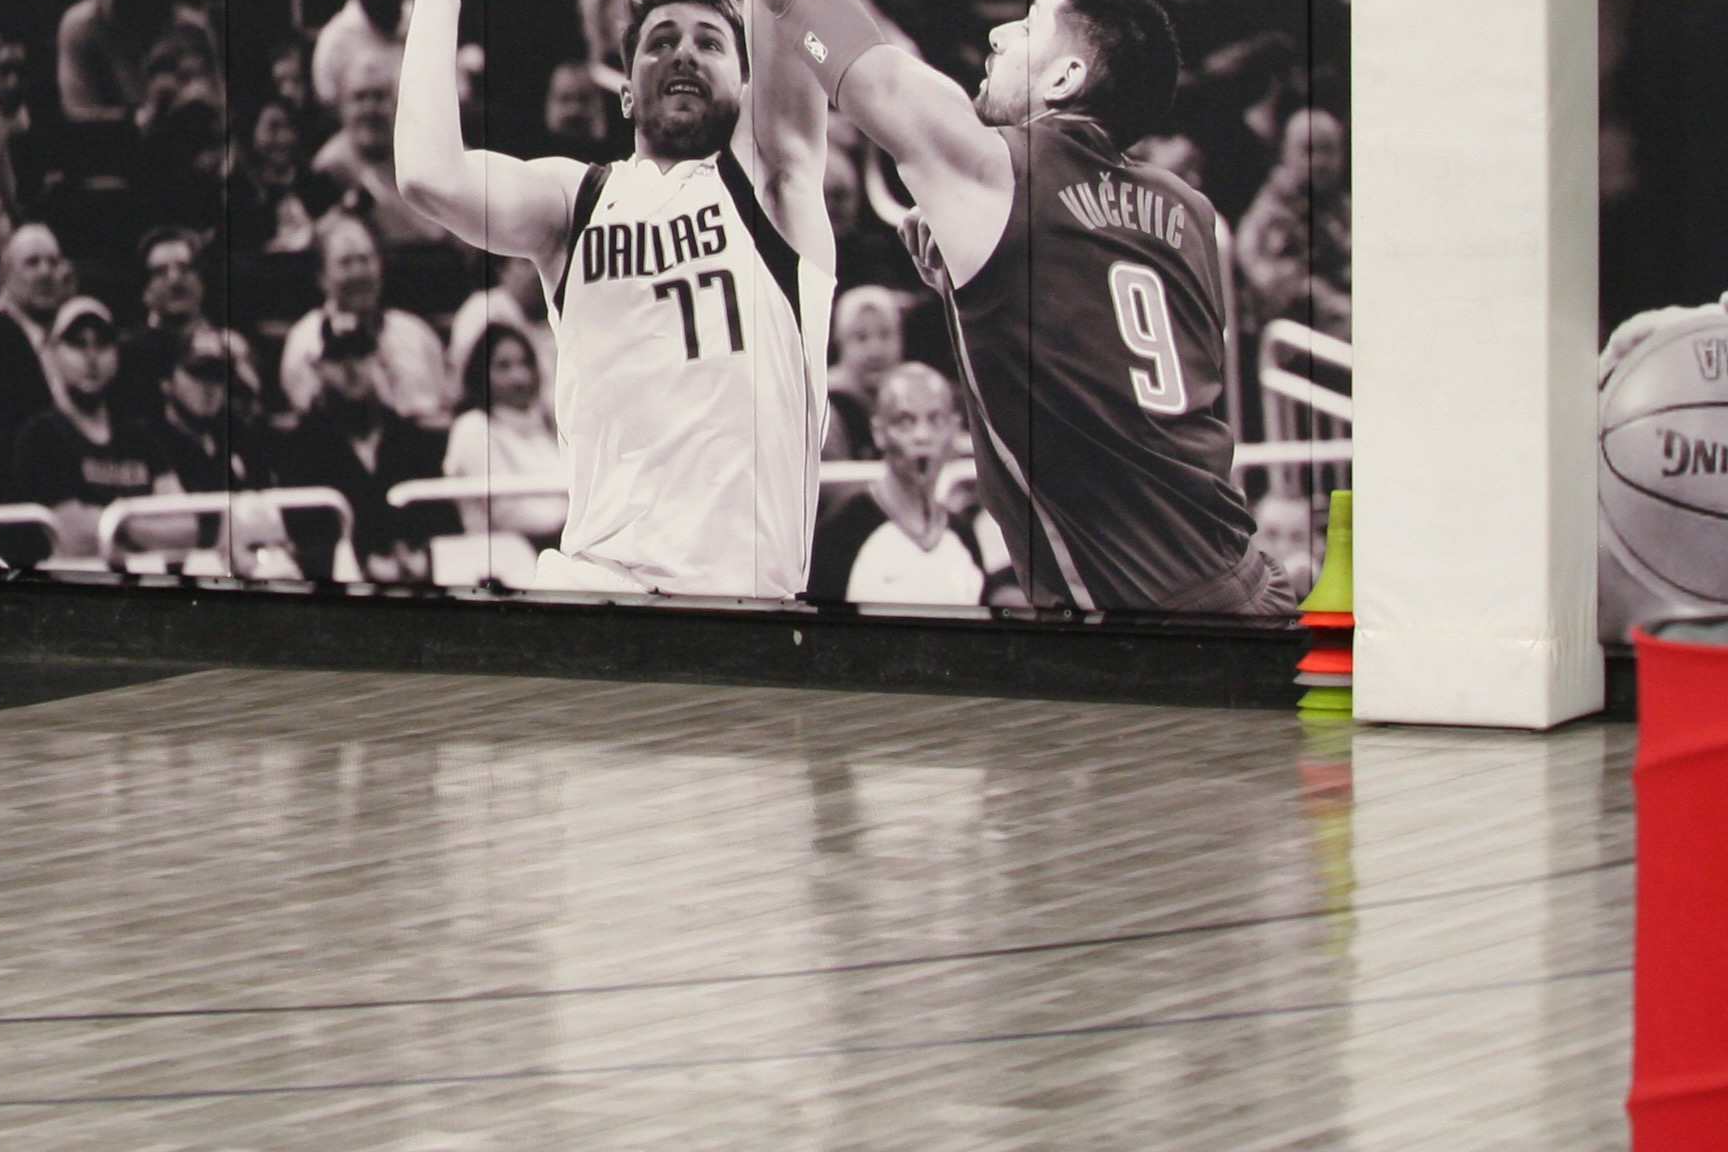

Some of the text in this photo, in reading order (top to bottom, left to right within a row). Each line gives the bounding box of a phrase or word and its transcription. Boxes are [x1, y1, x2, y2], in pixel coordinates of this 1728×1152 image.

[583, 202, 727, 286] DALLAS
[650, 269, 746, 363] 77
[1108, 260, 1188, 415] 9
